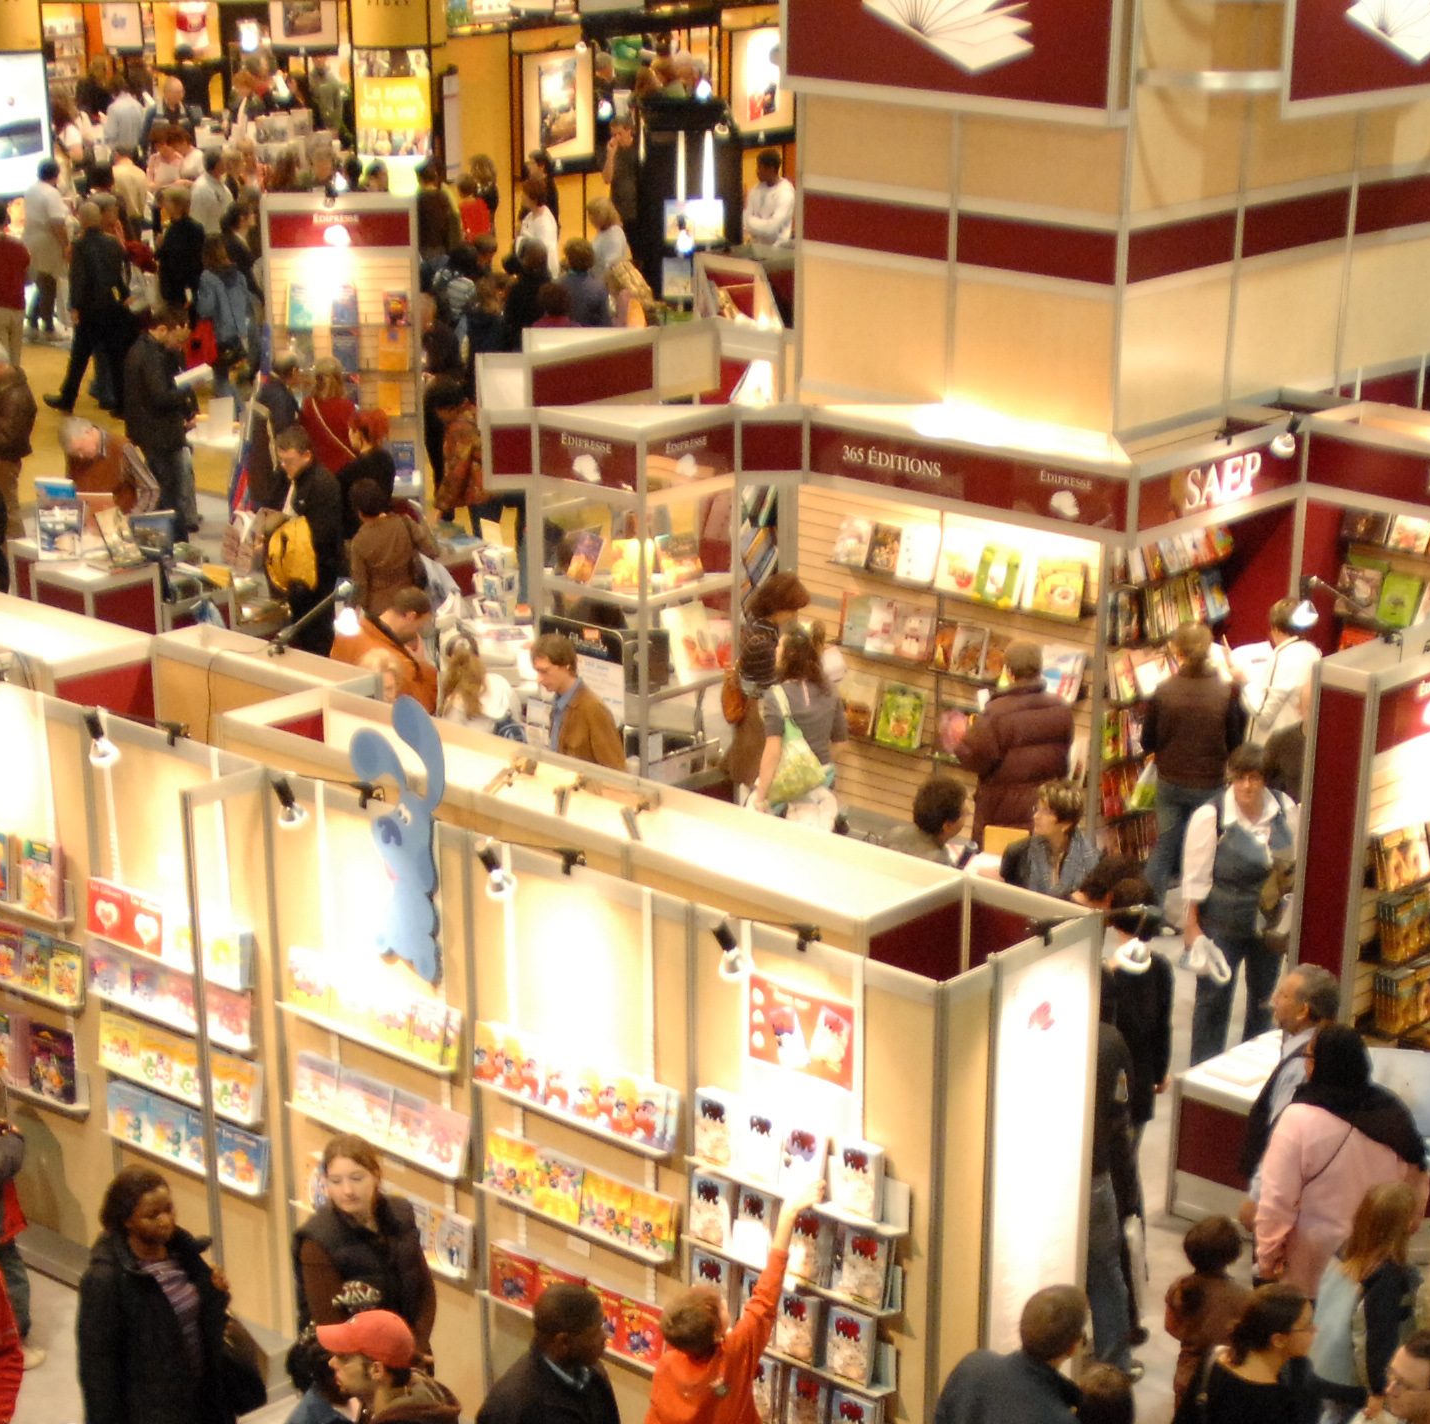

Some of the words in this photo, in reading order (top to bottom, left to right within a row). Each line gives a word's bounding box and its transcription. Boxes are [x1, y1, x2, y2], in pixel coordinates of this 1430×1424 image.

[560, 432, 613, 455] ÉDIPRESSE
[665, 435, 709, 455] ÉDIPRESSE
[842, 445, 865, 465] 365
[867, 446, 942, 479] ÉDITIONS
[1039, 469, 1093, 491] ÉDIPRESSE
[1184, 451, 1263, 510] SAEP
